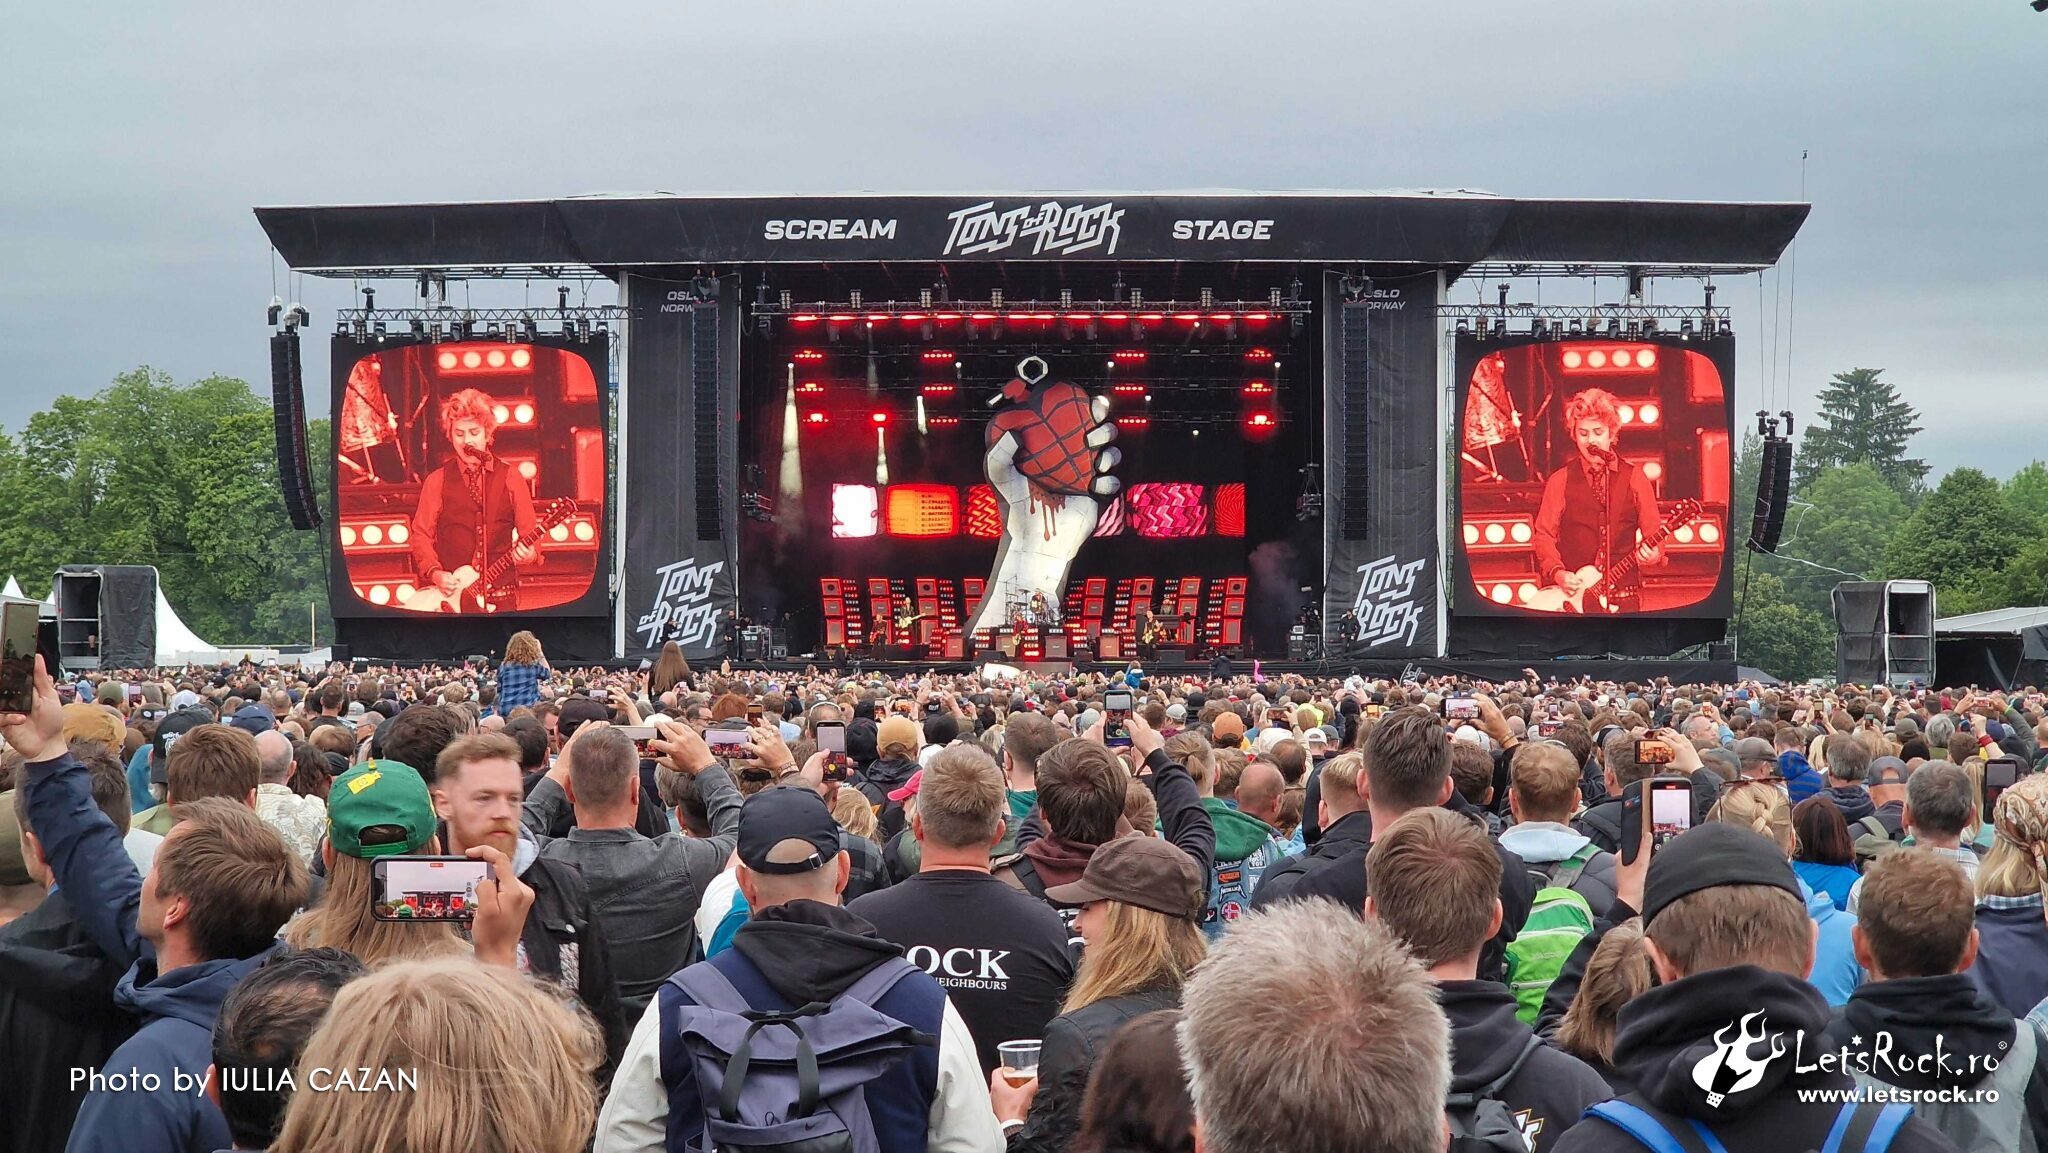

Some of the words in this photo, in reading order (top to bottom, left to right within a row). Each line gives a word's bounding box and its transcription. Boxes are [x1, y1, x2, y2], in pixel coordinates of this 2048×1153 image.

[764, 219, 898, 240] SCREAM
[943, 201, 1031, 256] TONS
[1019, 201, 1126, 256] ROCK
[1172, 219, 1275, 240] STAGE
[660, 304, 693, 313] NORW
[1367, 301, 1406, 310] ORWAY
[653, 557, 725, 610] TONS
[1354, 555, 1426, 608] TONS
[636, 601, 722, 649] ROCK
[1356, 599, 1424, 647] ROCK
[906, 945, 1011, 980] OCK
[935, 977, 1008, 991] EIGHBOURS
